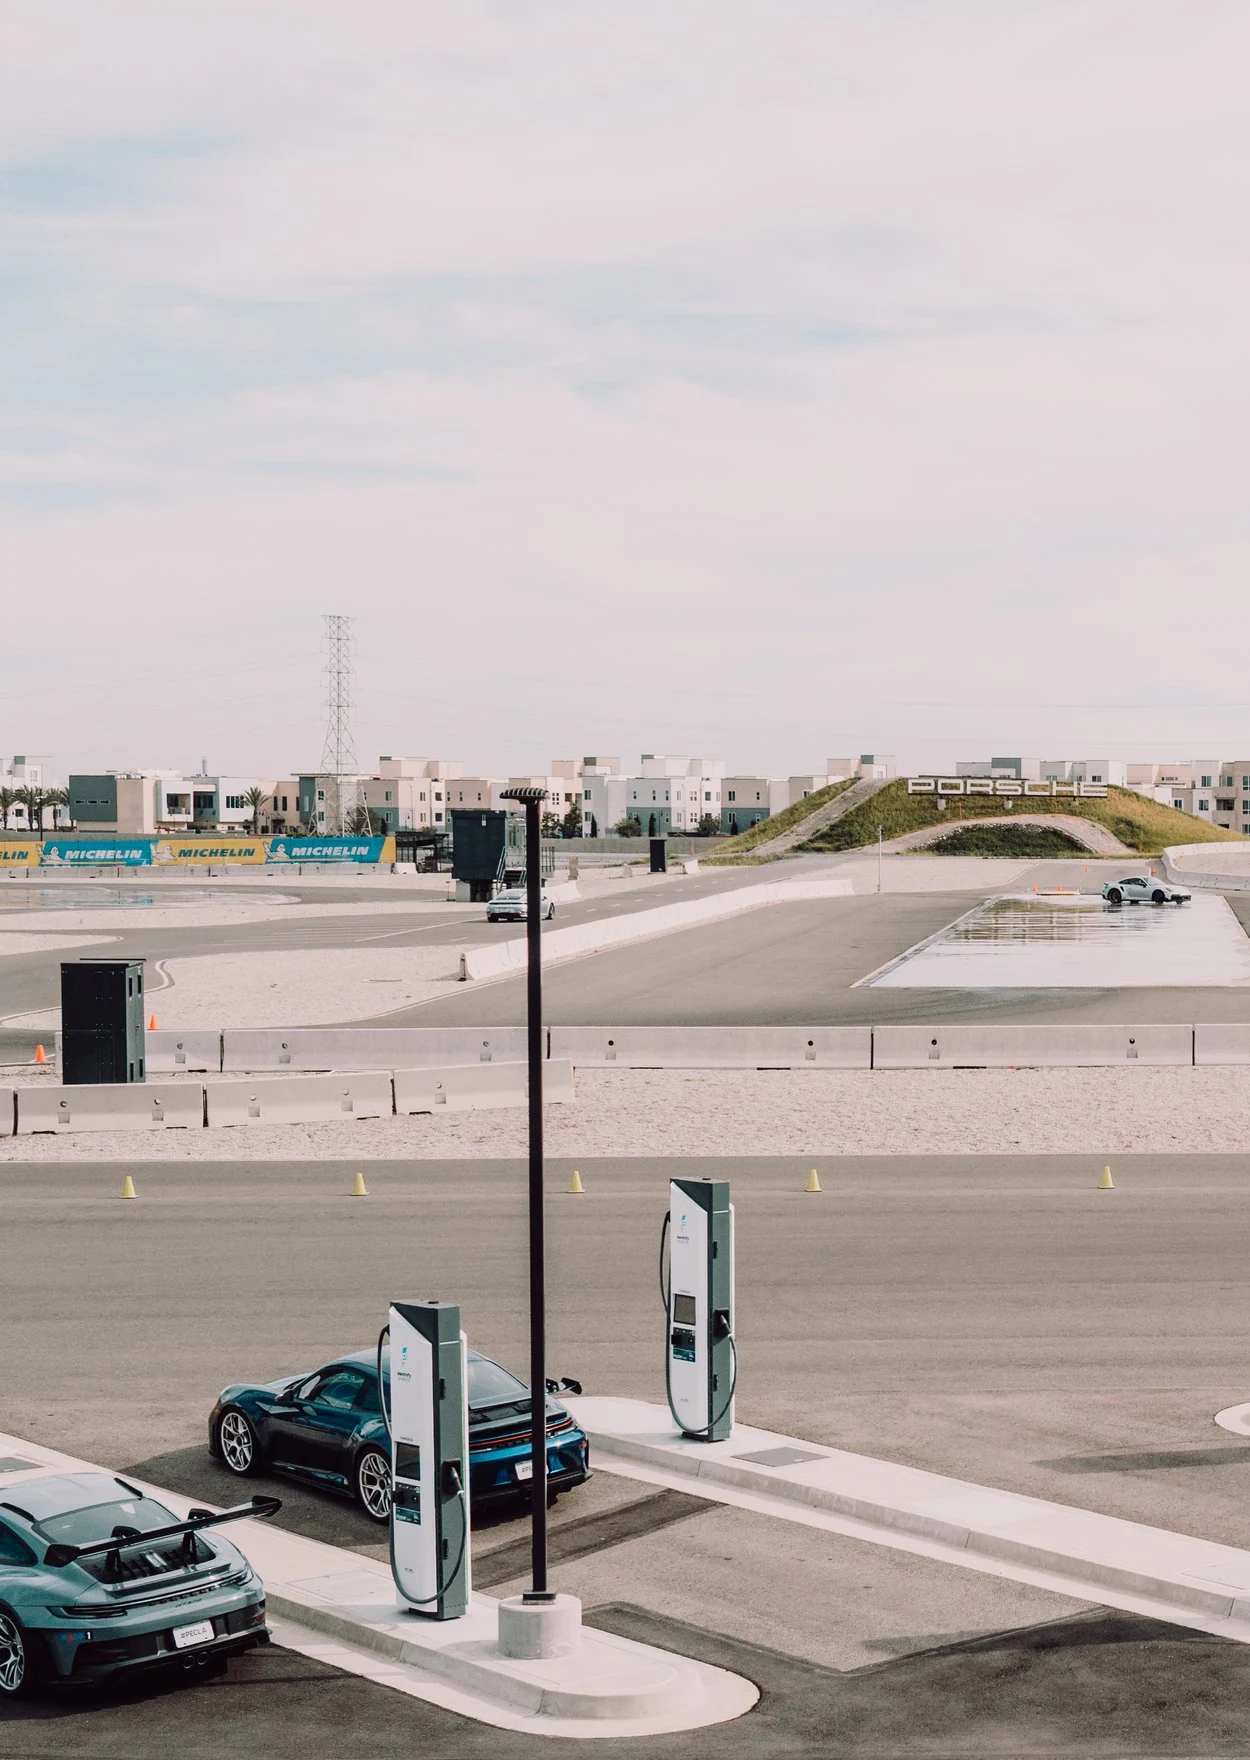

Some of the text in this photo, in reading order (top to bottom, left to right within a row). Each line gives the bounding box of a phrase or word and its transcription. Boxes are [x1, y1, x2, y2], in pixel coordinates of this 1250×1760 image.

[908, 778, 1107, 797] PORSCHE
[64, 849, 142, 859] MICHELIN
[178, 848, 254, 858] MICHELIN
[291, 846, 369, 856] MICHELIN
[180, 1627, 207, 1639] #PECLA
